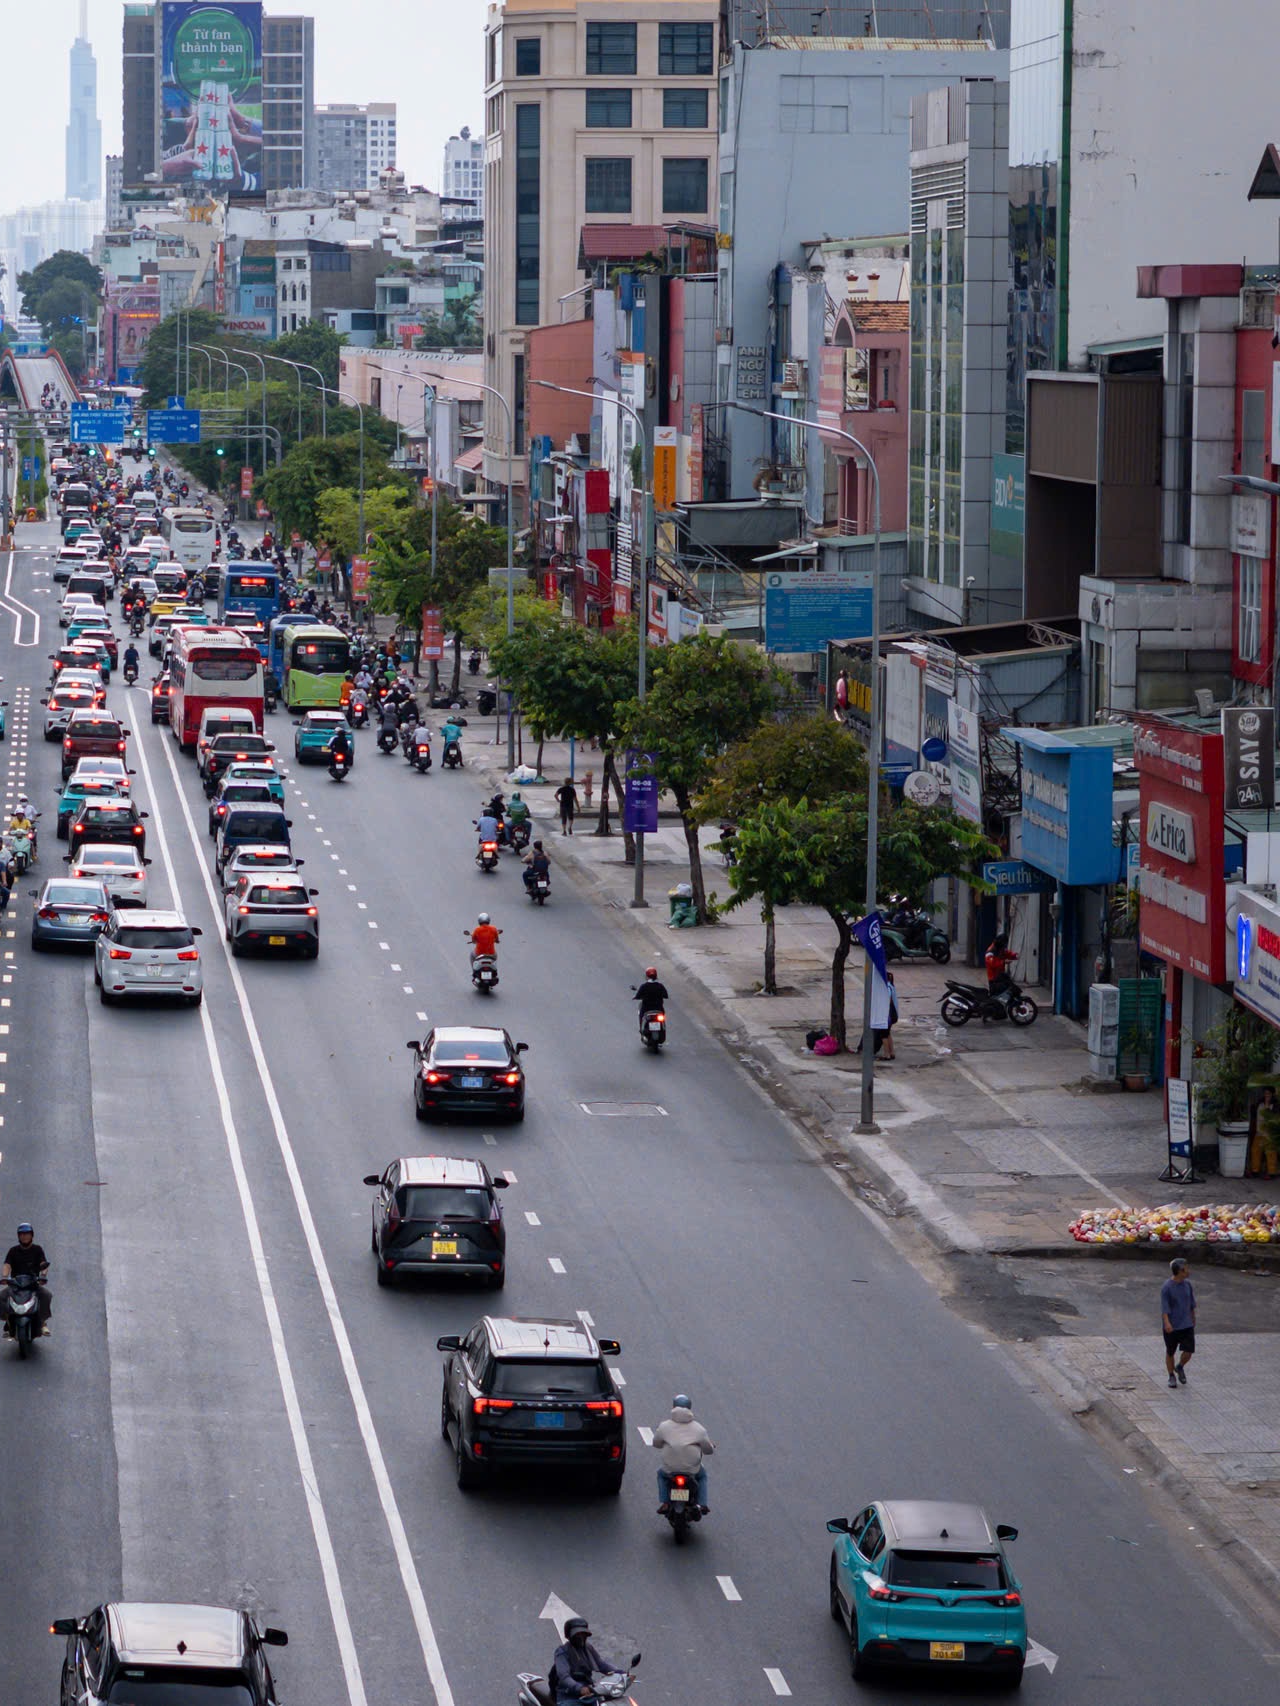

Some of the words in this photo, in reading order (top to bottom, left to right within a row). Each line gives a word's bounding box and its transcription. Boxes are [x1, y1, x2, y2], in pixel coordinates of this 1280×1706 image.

[193, 28, 209, 40] Từ
[212, 28, 231, 40] fan
[181, 41, 217, 53] thành
[220, 41, 243, 56] bạn
[222, 321, 266, 331] VINCOM
[739, 346, 765, 356] ANH
[742, 389, 760, 399] EM
[1240, 738, 1260, 779] SAY
[1239, 786, 1261, 803] 24h
[1161, 813, 1187, 856] Erica
